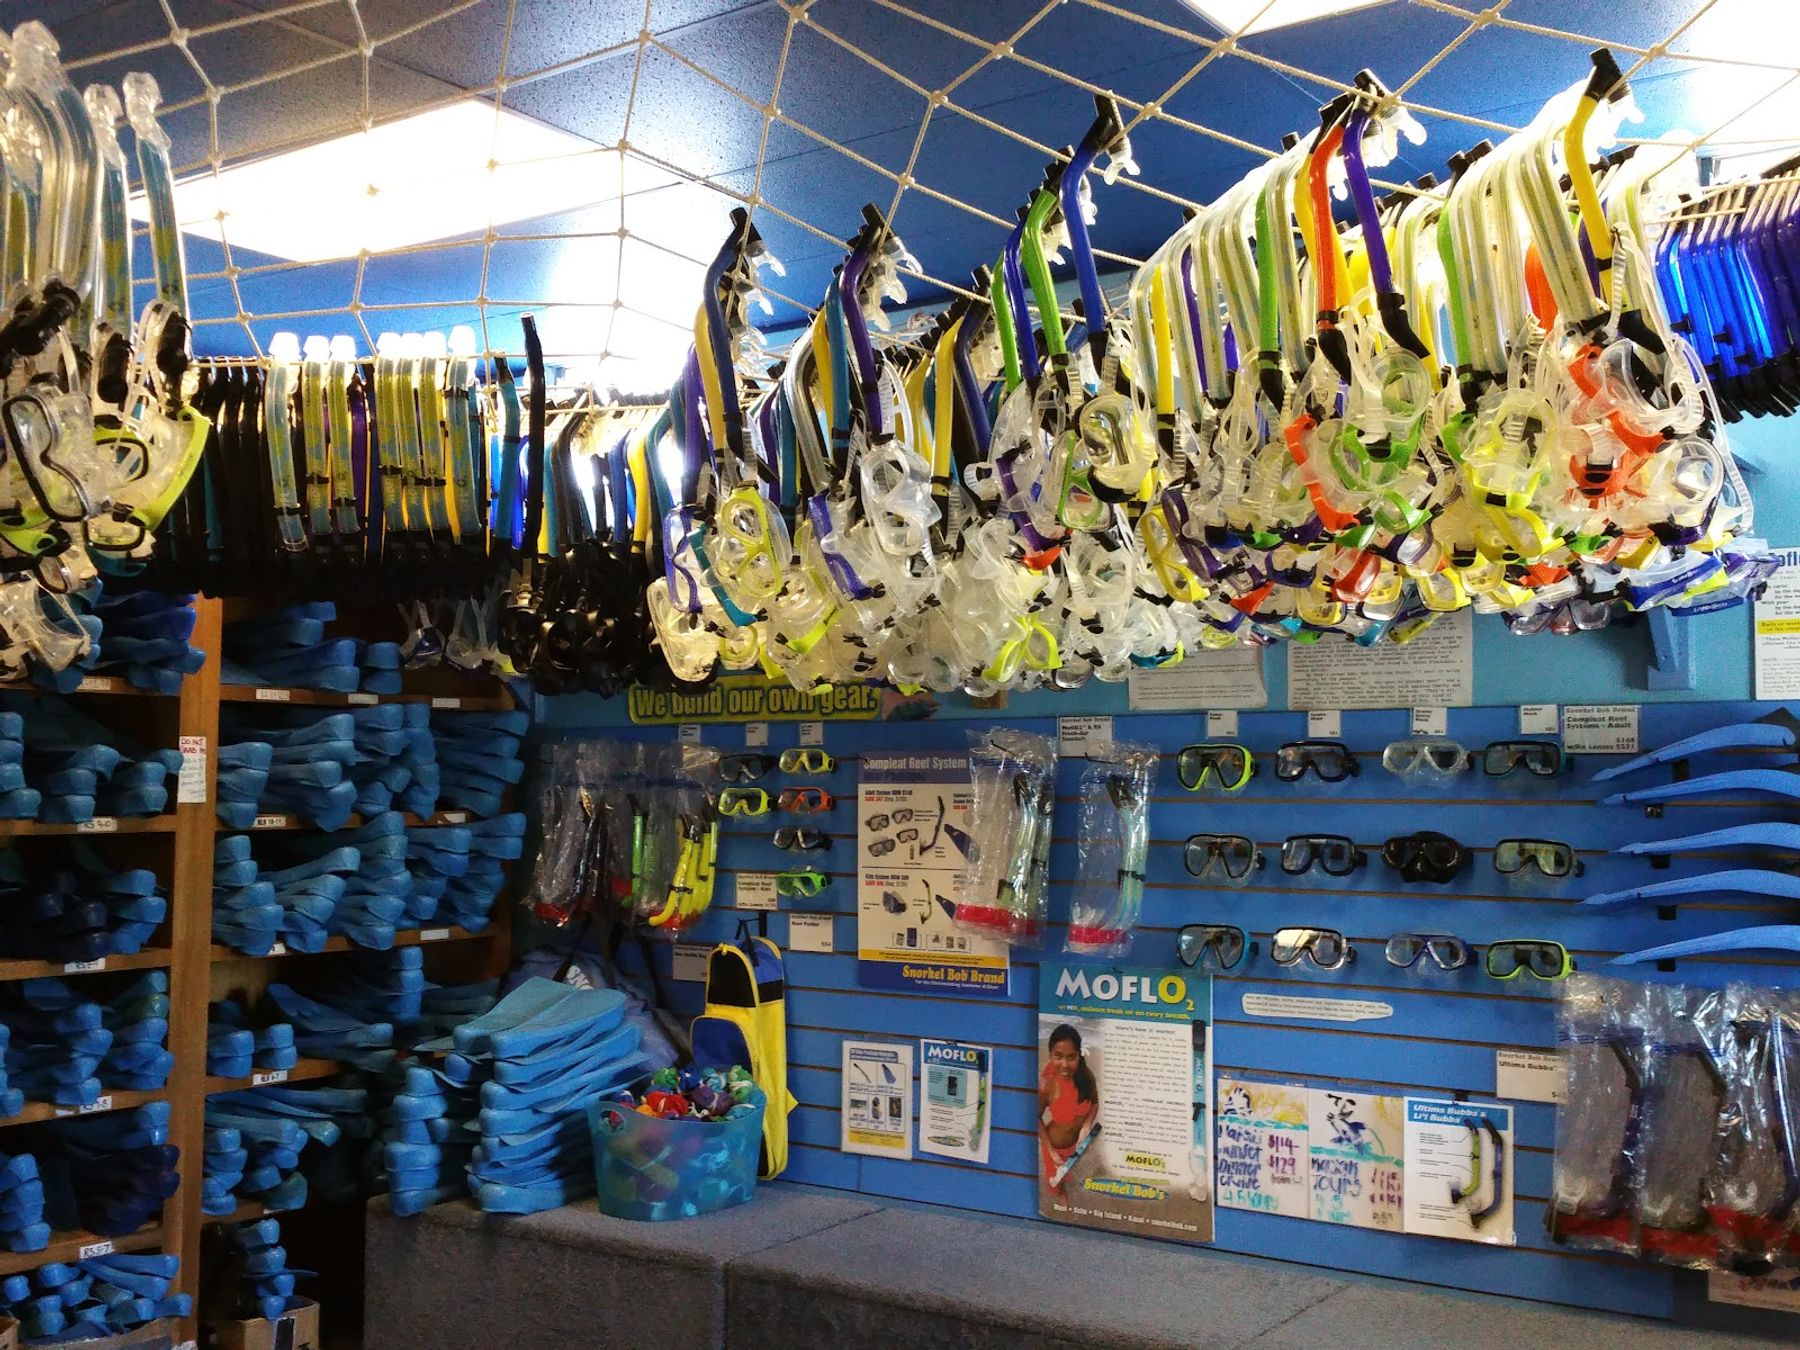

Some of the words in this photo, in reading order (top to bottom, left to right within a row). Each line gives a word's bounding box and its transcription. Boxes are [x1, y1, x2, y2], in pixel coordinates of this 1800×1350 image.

[635, 689, 667, 716] We
[728, 687, 763, 714] our
[767, 687, 814, 713] own
[820, 684, 877, 715] gear.
[932, 757, 967, 770] System
[902, 964, 944, 979] Snorkel
[946, 968, 968, 981] Bob
[970, 969, 1005, 984] Brand
[1413, 1103, 1445, 1113] Ultima
[1083, 1177, 1130, 1195] Snorkel
[1132, 1184, 1166, 1200] Bob's
